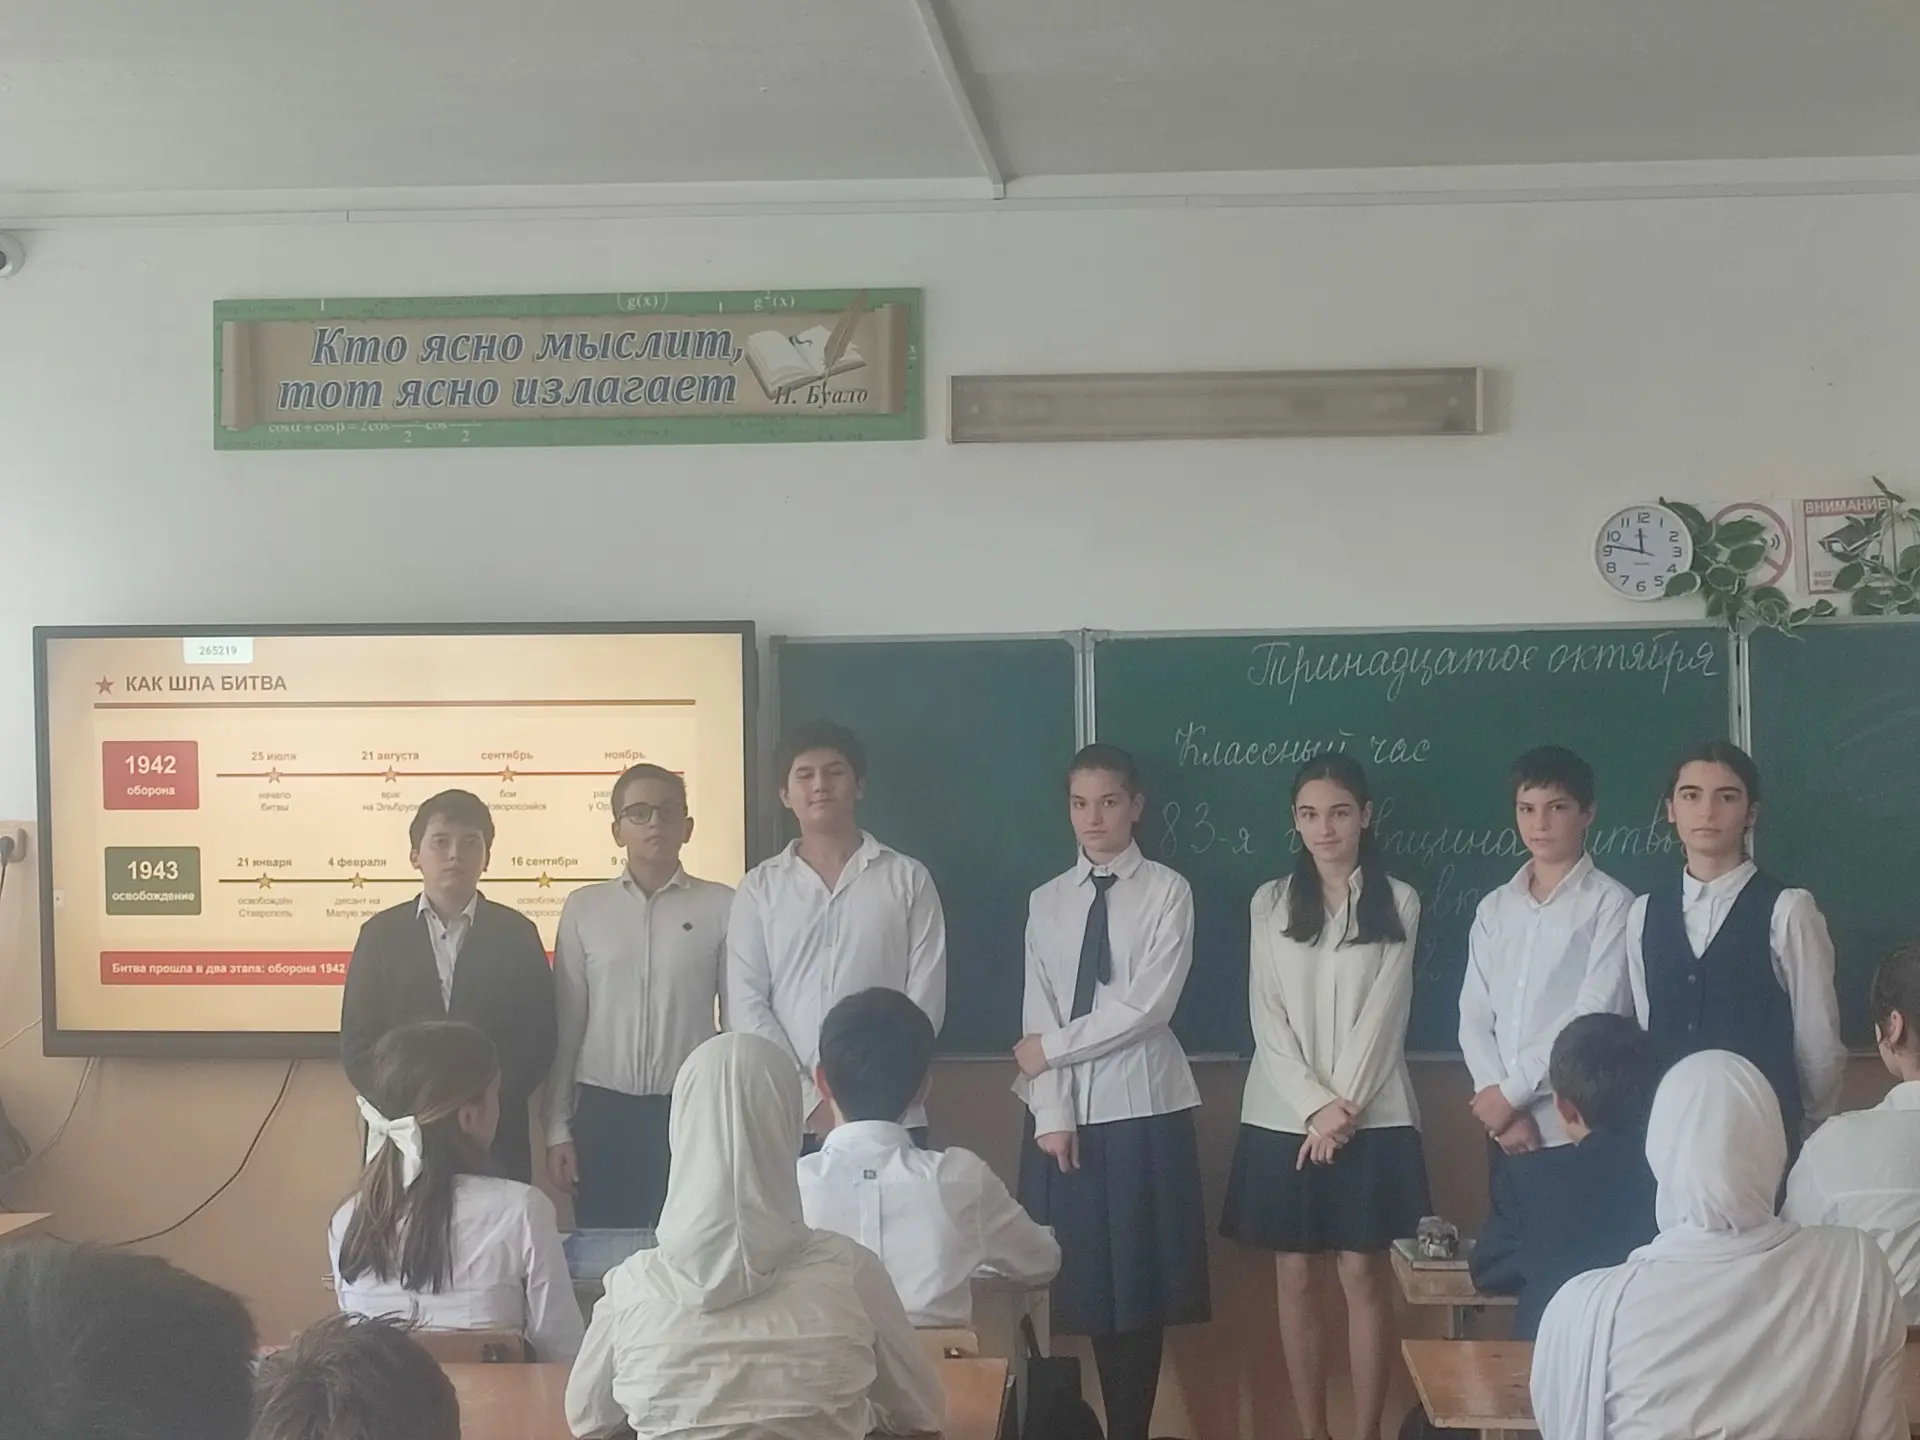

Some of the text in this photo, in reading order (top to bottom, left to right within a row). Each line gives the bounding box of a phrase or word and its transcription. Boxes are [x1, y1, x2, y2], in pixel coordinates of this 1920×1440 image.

[311, 326, 743, 367] Кто ясно мыслит,
[277, 371, 738, 411] тот ясно излагает
[774, 384, 869, 409] Н. Буало
[1621, 517, 1630, 528] 11
[1637, 512, 1651, 524] 12
[1606, 530, 1621, 542] 10
[1669, 530, 1679, 542] 2
[1672, 546, 1682, 557] 3
[1606, 562, 1616, 573] 8
[1666, 563, 1677, 573] 4
[1620, 575, 1630, 586] 7
[1636, 581, 1646, 592] 6
[1654, 575, 1664, 587] 5
[199, 645, 238, 656] 265219
[1247, 631, 1719, 706] Тринадцатое октября
[126, 675, 287, 692] КАК ШЛА БИТВА
[481, 750, 534, 761] сентябрь
[604, 749, 646, 760] ноябрь
[1370, 735, 1431, 765] час
[251, 751, 297, 762] 25 июля
[361, 751, 420, 763] 21 августа
[125, 754, 177, 775] 1942
[126, 783, 175, 797] оборона
[1160, 801, 1256, 857] 83-я
[237, 857, 292, 869] 21 января
[328, 857, 387, 868] 4 февраля
[511, 856, 578, 868] 16 сентября
[127, 860, 179, 880] 1943
[112, 890, 195, 902] освобождение
[112, 962, 345, 975] Битва прошла в два этапа: оборона 1942
